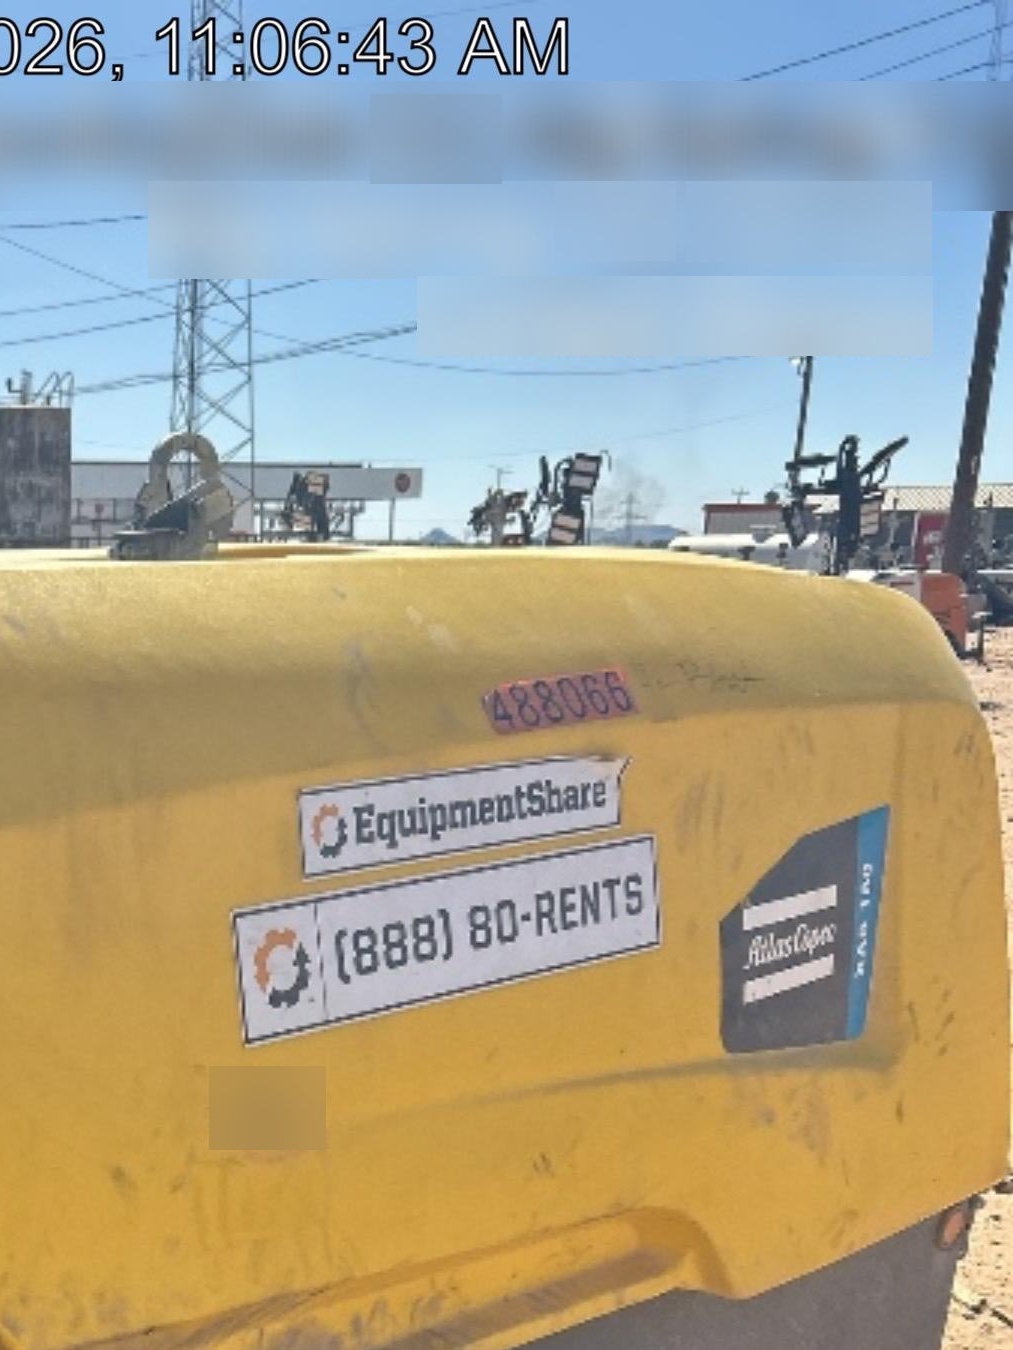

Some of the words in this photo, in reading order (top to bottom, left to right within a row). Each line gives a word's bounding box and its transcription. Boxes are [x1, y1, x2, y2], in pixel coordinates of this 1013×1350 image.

[492, 669, 633, 728] 488066
[352, 779, 607, 849] EquipmentShare
[335, 908, 453, 984] (888)
[468, 873, 643, 950] 80-RENTS
